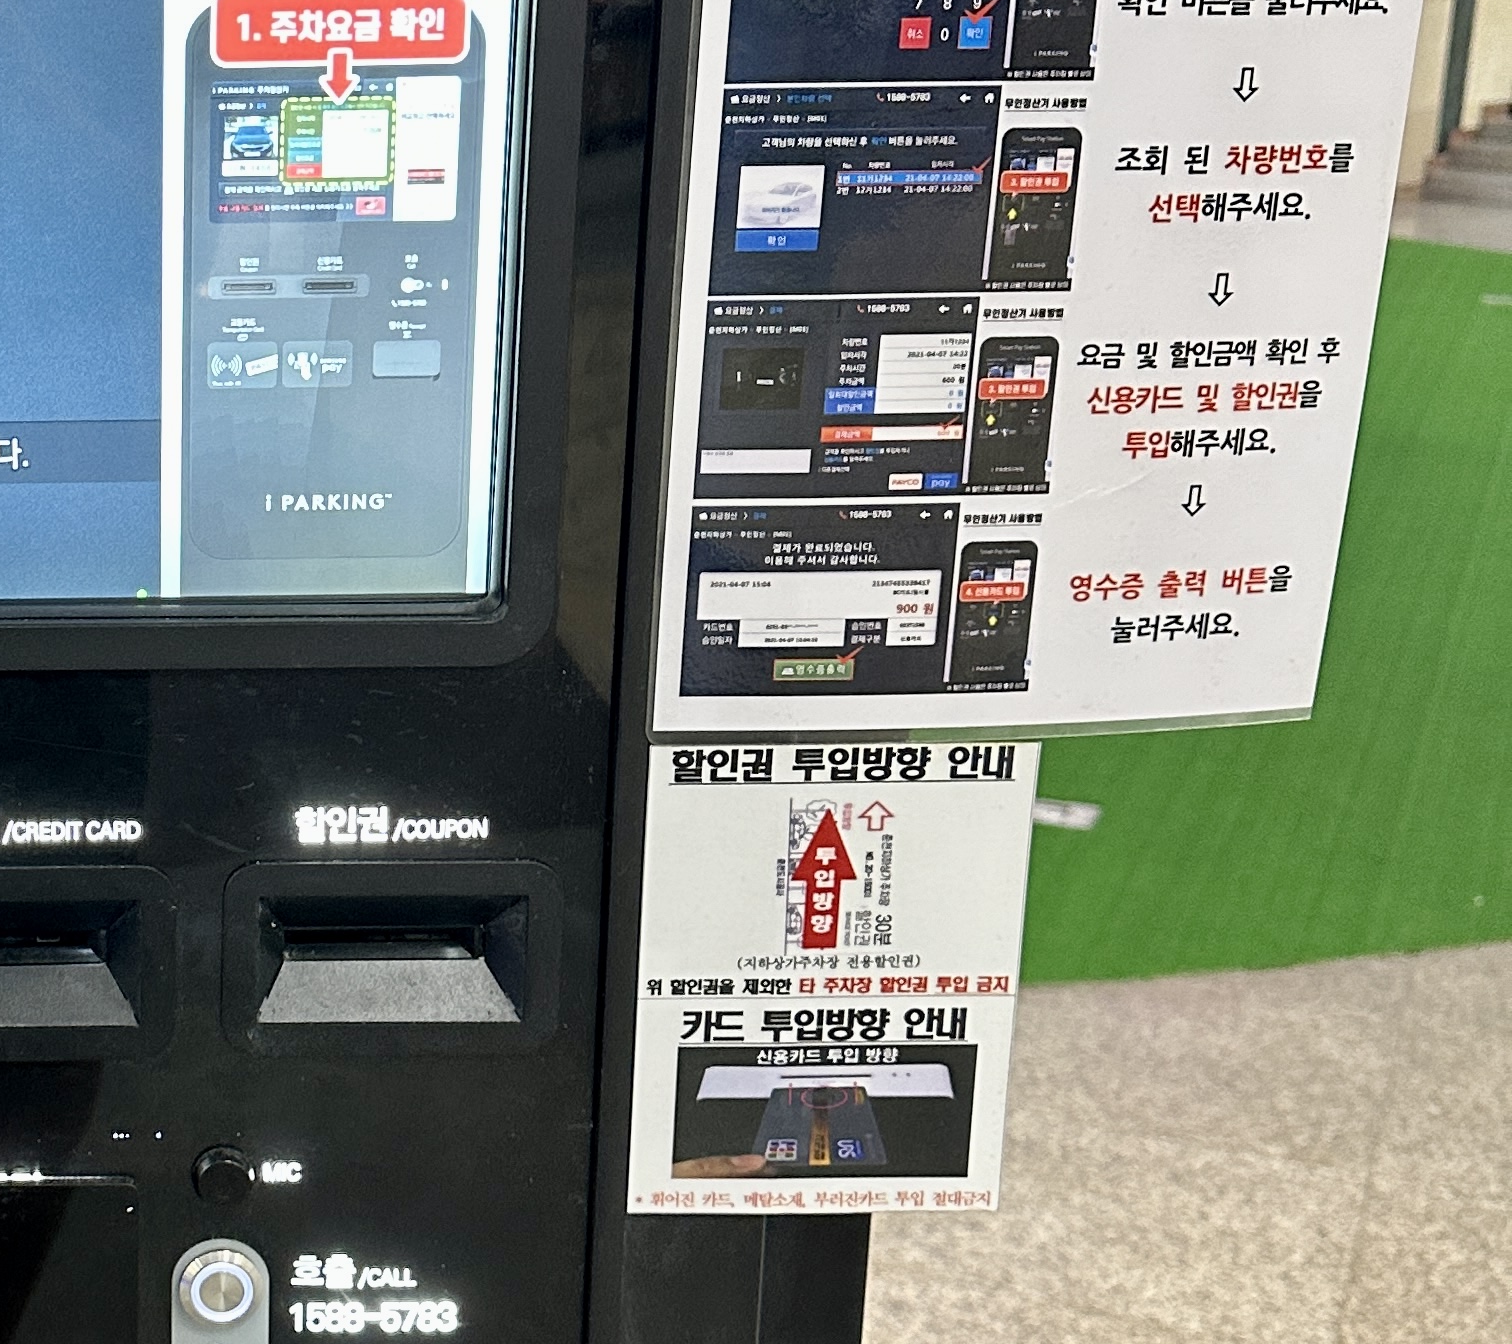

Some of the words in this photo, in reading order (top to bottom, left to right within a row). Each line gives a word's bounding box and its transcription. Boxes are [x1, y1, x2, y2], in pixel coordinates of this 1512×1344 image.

[236, 13, 262, 43] 1.
[269, 9, 382, 44] 주차요금
[389, 6, 446, 42] 확인
[1114, 145, 1169, 175] 조회
[1184, 144, 1210, 175] 된
[1224, 141, 1356, 176] 차량번호를
[1147, 192, 1313, 225] 선택해주세요.
[1076, 343, 1126, 370] 요금
[1135, 341, 1160, 370] 및
[1169, 338, 1257, 369] 할인금액
[1264, 338, 1309, 366] 확인
[1317, 337, 1342, 363] 후
[1086, 384, 1185, 416] 신용카드
[1195, 382, 1220, 413] 및
[1231, 379, 1323, 411] 할인권을
[1121, 426, 1277, 458] 투입해주세요.
[1069, 572, 1145, 603] 영수증
[1157, 569, 1207, 599] 출력
[1221, 565, 1293, 596] 버튼을
[1109, 612, 1240, 644] 눌러주세요.
[672, 747, 774, 783] 할인권
[792, 746, 932, 782] 투입방향
[947, 744, 1015, 780] 안내
[86, 819, 143, 844] CARD
[293, 805, 389, 845] 할인권
[392, 815, 489, 844] /COUPON
[742, 977, 792, 996] 제외한
[976, 975, 1009, 993] 금지
[681, 1009, 745, 1042] 카드
[761, 1007, 890, 1042] 투입방향
[903, 1006, 969, 1041] 안내
[756, 1048, 821, 1065] 신용카드
[864, 1047, 899, 1064] 방향
[261, 1162, 303, 1183] MIC
[289, 1253, 356, 1290] 호출
[357, 1267, 417, 1290] /CALL
[289, 1300, 459, 1334] 1588-5783
